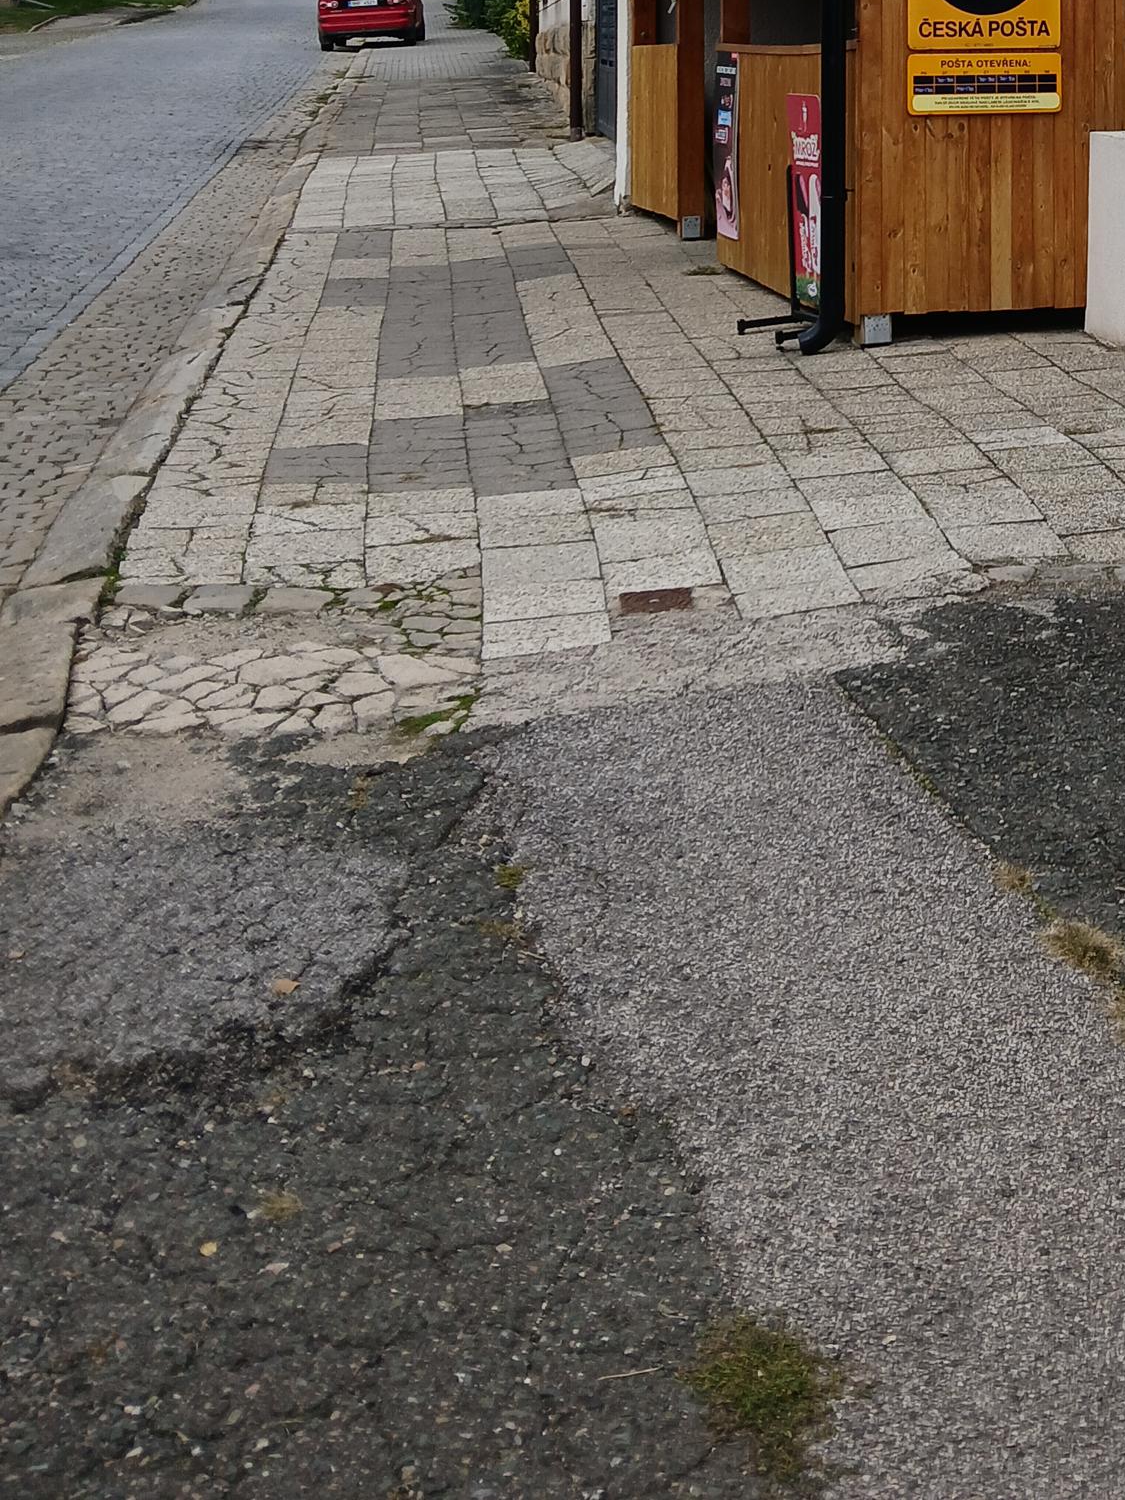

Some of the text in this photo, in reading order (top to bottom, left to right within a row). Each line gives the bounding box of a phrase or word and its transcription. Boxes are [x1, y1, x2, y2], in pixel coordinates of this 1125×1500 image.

[918, 17, 1050, 38] ČESKÁ POŠTA
[940, 57, 1032, 68] POŠTA OTEVŘENA:
